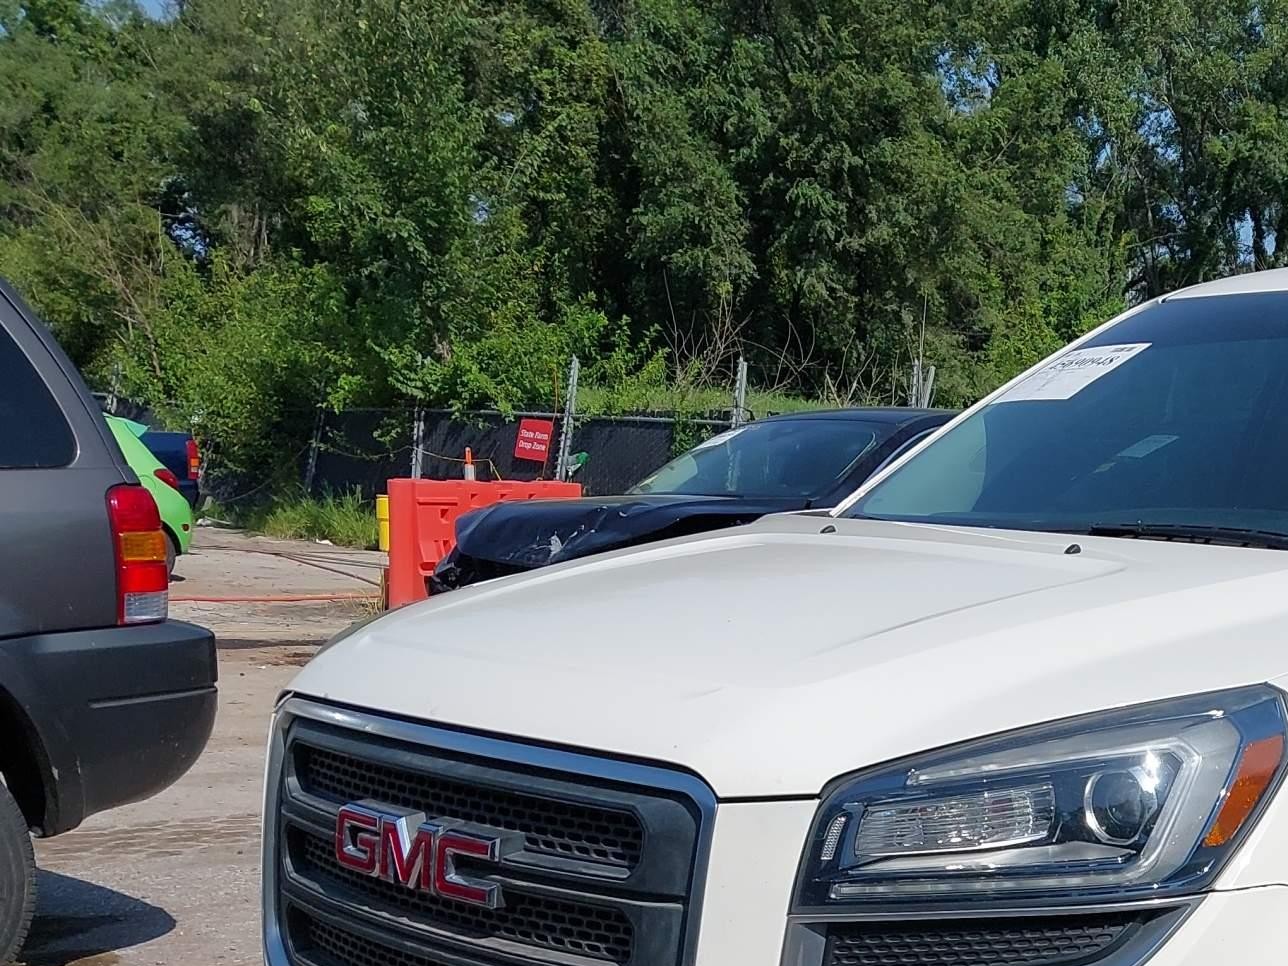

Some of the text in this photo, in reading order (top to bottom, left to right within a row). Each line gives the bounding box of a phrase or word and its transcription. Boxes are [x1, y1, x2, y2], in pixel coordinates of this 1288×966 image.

[520, 429, 549, 440] State Farm
[518, 440, 546, 451] Drop Zone
[335, 801, 505, 910] GMC
